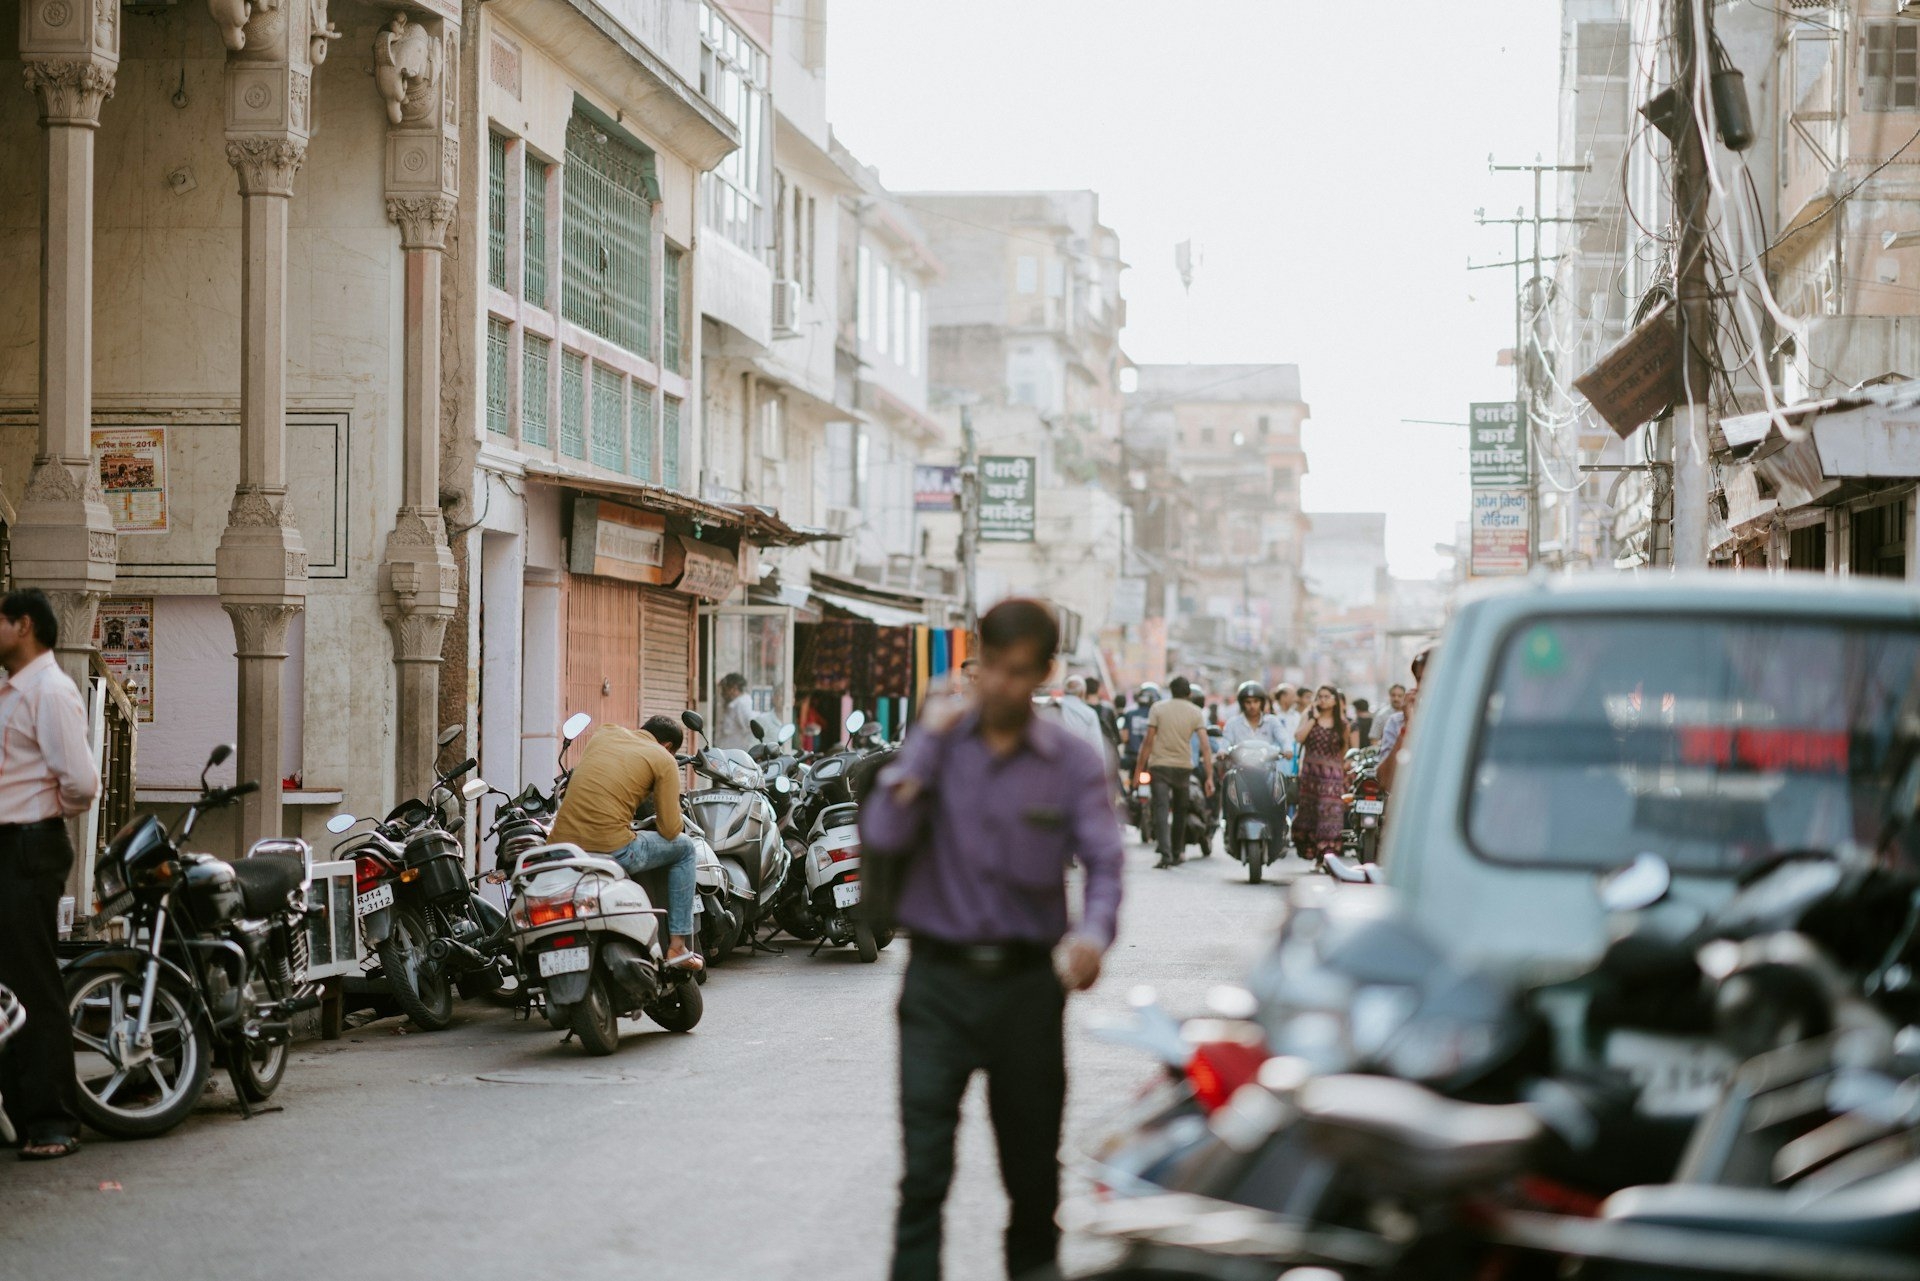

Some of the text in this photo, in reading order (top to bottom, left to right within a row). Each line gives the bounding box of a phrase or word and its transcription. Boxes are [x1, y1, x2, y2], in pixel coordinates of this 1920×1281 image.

[1475, 403, 1518, 422] शादी
[1477, 422, 1517, 443] कार्ड
[985, 458, 1029, 478] शादी
[987, 479, 1027, 499] कार्ड
[357, 889, 382, 905] RJ14
